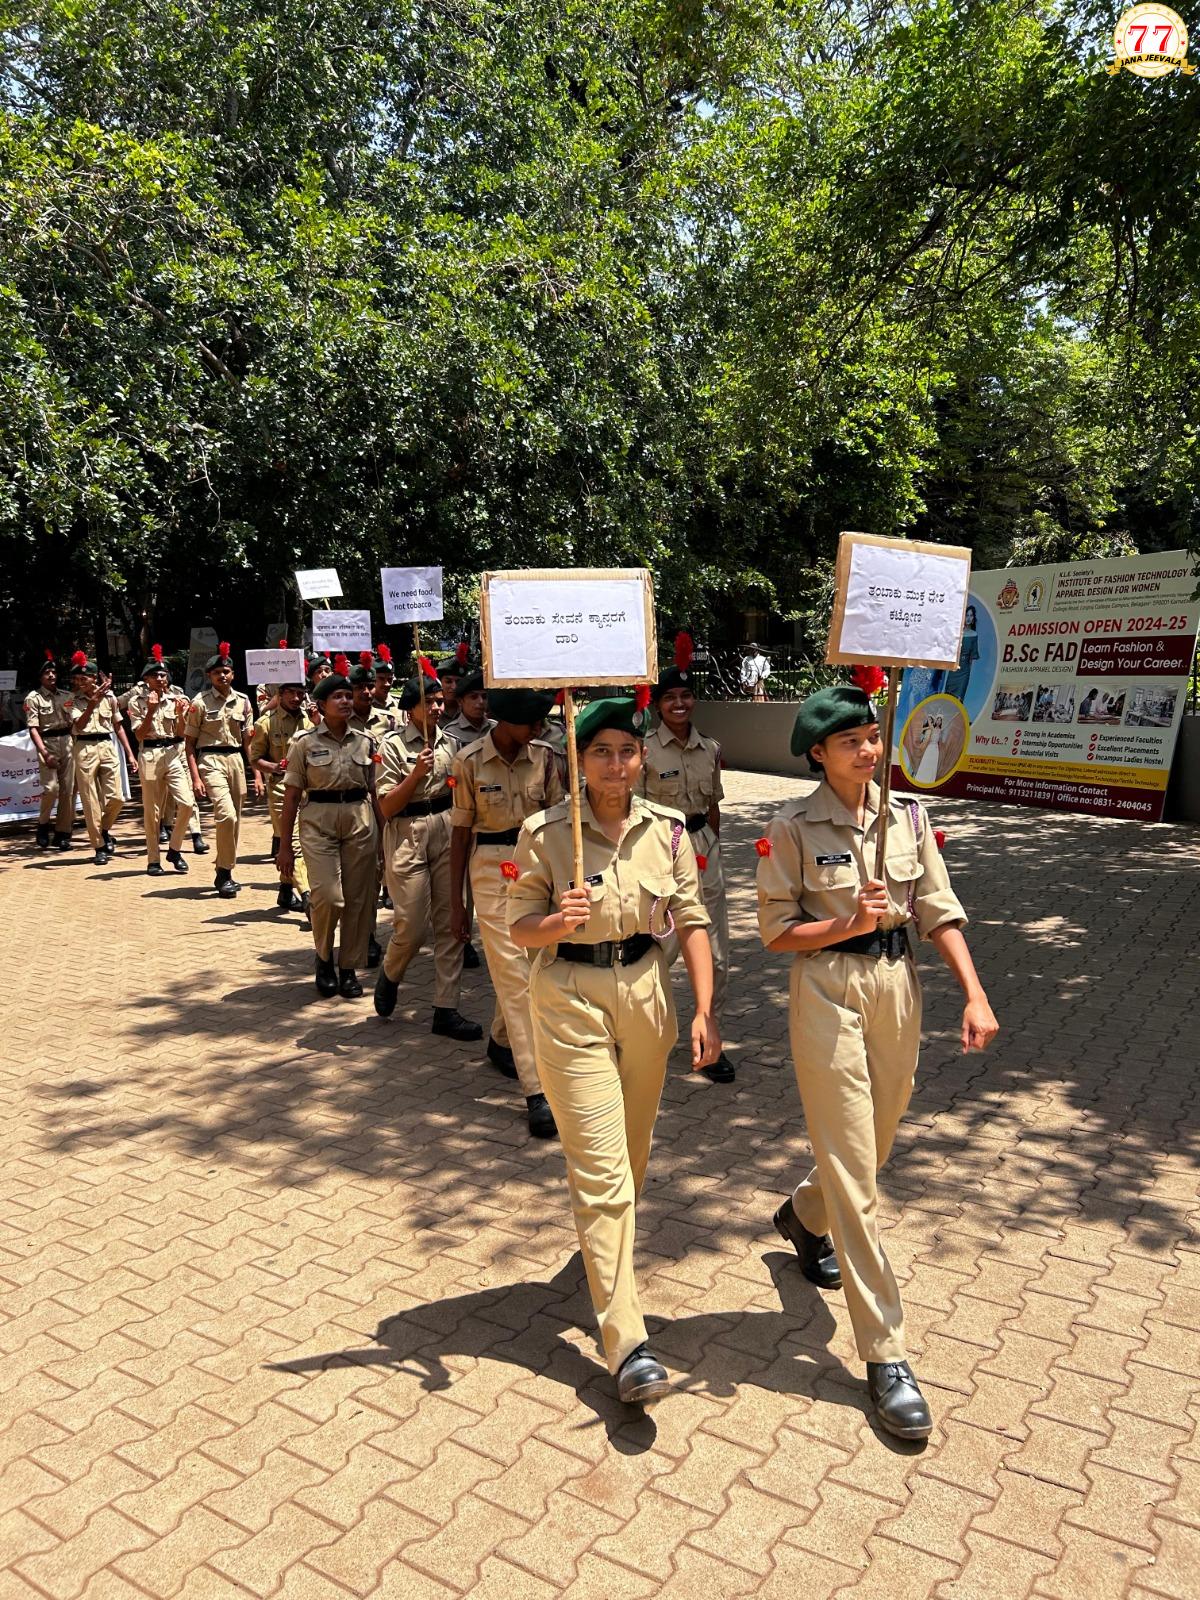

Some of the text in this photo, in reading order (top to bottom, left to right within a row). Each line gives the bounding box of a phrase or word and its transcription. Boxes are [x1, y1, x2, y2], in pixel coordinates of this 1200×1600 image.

[1058, 577, 1092, 588] INSTITUTE
[1093, 576, 1103, 585] OF
[1104, 573, 1135, 584] FASHION
[1138, 569, 1188, 581] TECHNOLOGY
[388, 590, 400, 598] We
[401, 590, 417, 598] need
[868, 586, 902, 599] ತಂಬಾಕು
[906, 590, 926, 607] ಮುಕ್ತ
[1056, 583, 1161, 599] APPAREL DESIGN FOR WOMEN
[406, 602, 432, 610] tobacco
[504, 614, 546, 625] ತಂಬಾಕು
[551, 612, 583, 624] ಸೇವನೆ
[889, 609, 922, 628] ಕಟ್ಟೋಣ
[1008, 616, 1188, 637] ADMISSION OPEN 2024-25
[555, 634, 579, 644] ದಾರಿ
[1003, 642, 1077, 663] B.Sc FAD
[1083, 640, 1165, 654] Learn Fashion &
[1080, 659, 1114, 671] Design
[1117, 658, 1141, 669] Your
[975, 735, 990, 746] Why
[1023, 731, 1041, 740] Strong
[1047, 732, 1075, 740] Academics
[1099, 734, 1163, 745] Experienced Faculties
[1021, 740, 1083, 750] Internship Opportunities
[1097, 744, 1160, 755] Excellent Placements
[1020, 749, 1059, 758] Industrial Visits
[1095, 754, 1164, 765] Incampus Ladies Hostel
[1004, 778, 1108, 796] For More Information Contact
[966, 783, 994, 795] Principal
[994, 786, 1006, 795] No:
[1008, 788, 1050, 800] 9113211839
[1057, 793, 1079, 803] Office
[1080, 796, 1092, 805] no:
[1116, 800, 1152, 811] 2404045
